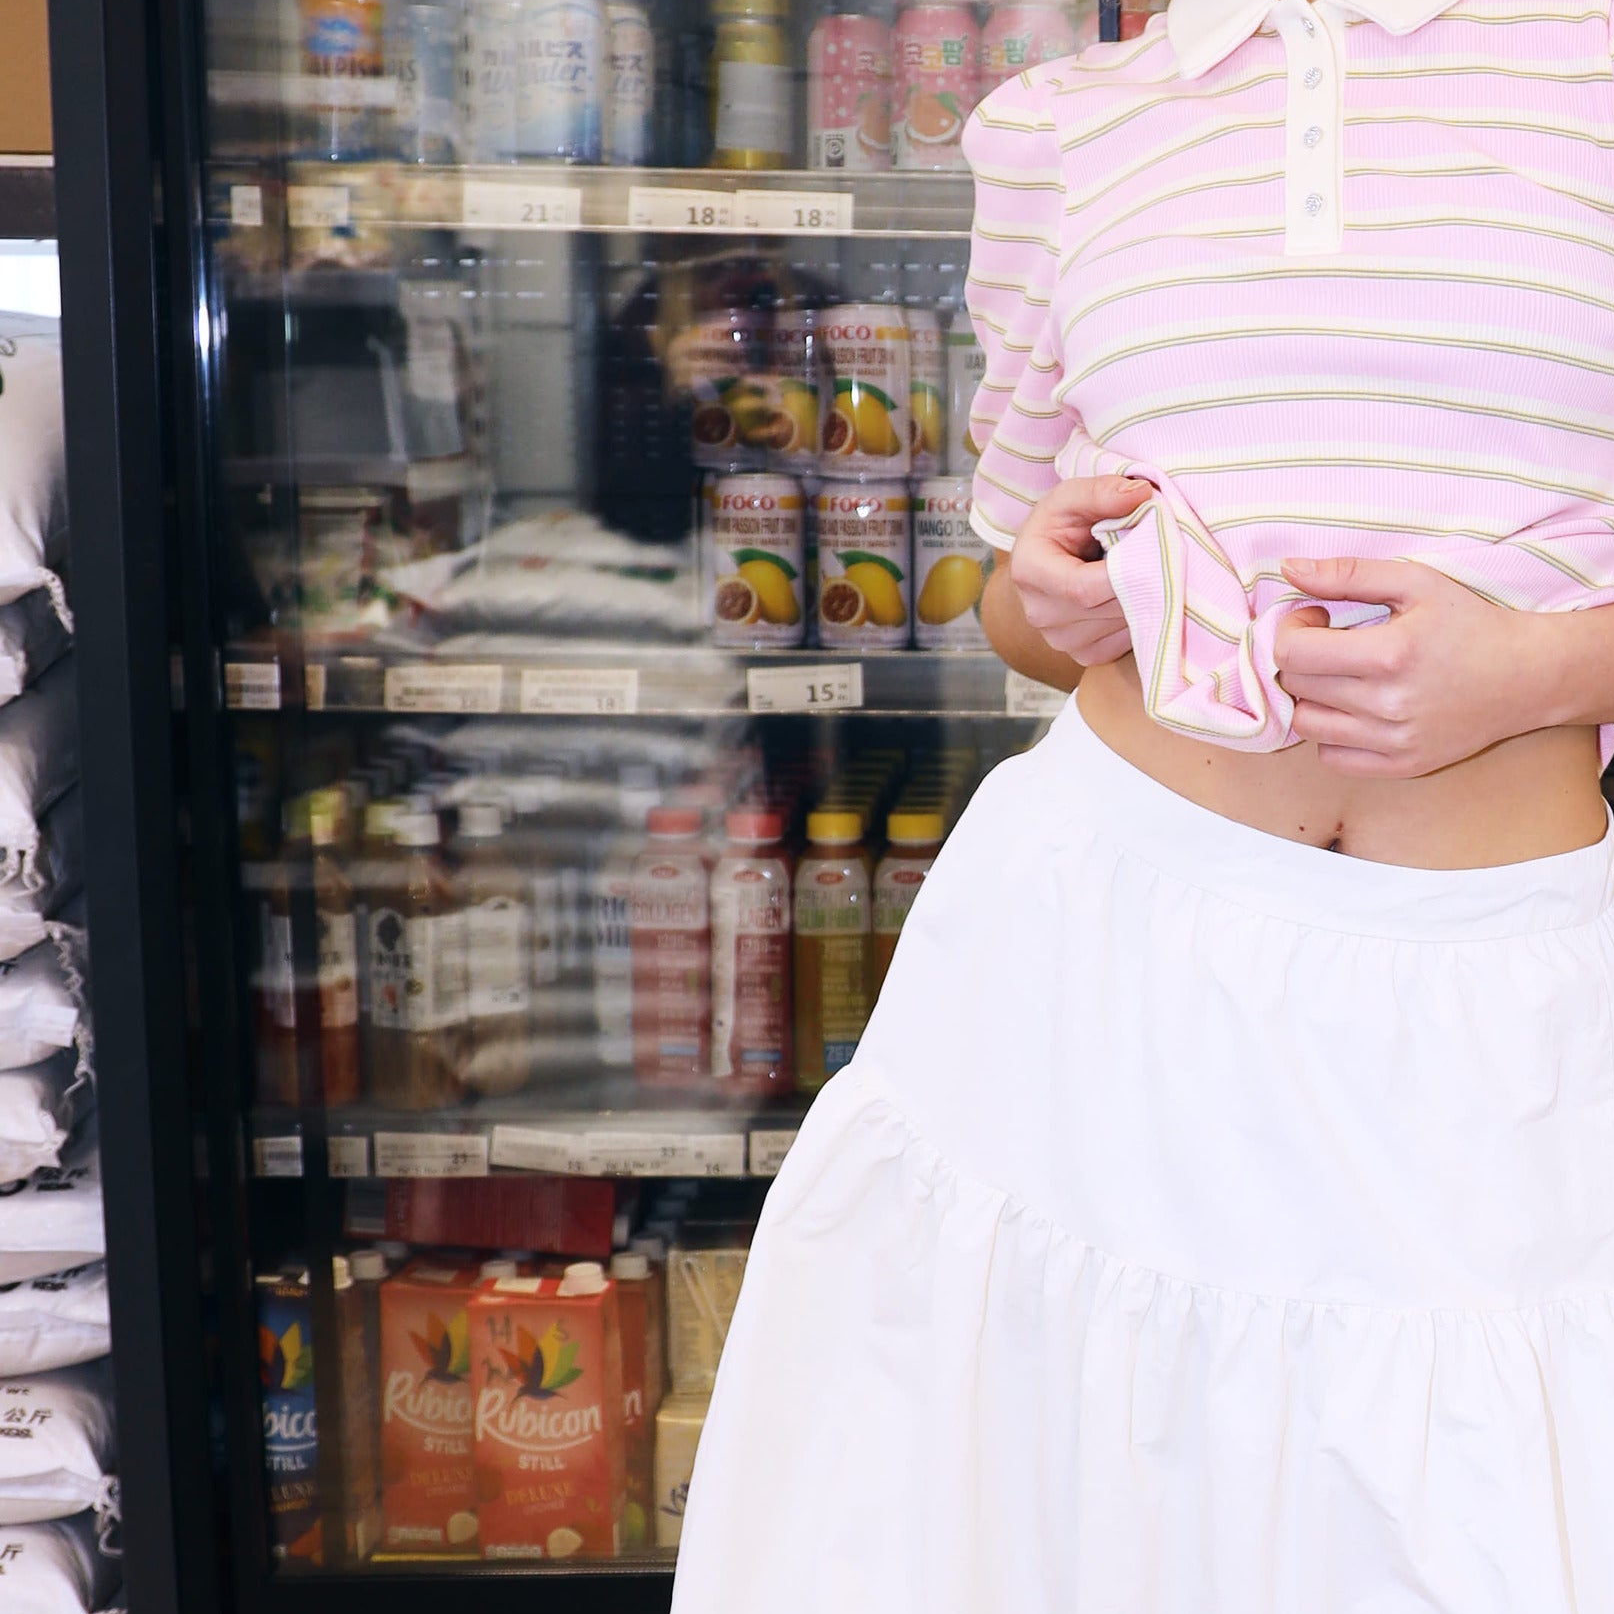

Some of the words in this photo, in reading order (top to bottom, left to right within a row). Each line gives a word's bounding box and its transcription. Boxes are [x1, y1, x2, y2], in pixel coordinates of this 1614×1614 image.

[521, 203, 549, 222] 21
[686, 206, 714, 226] 18
[793, 208, 822, 227] 18
[721, 495, 775, 511] FOCO
[829, 496, 882, 512] FOCO
[918, 519, 954, 536] MANGO
[806, 684, 834, 703] 15
[383, 1371, 472, 1423] Rubic
[475, 1388, 601, 1442] Rubicon
[423, 1437, 468, 1454] STILL
[517, 1453, 566, 1471] STILL
